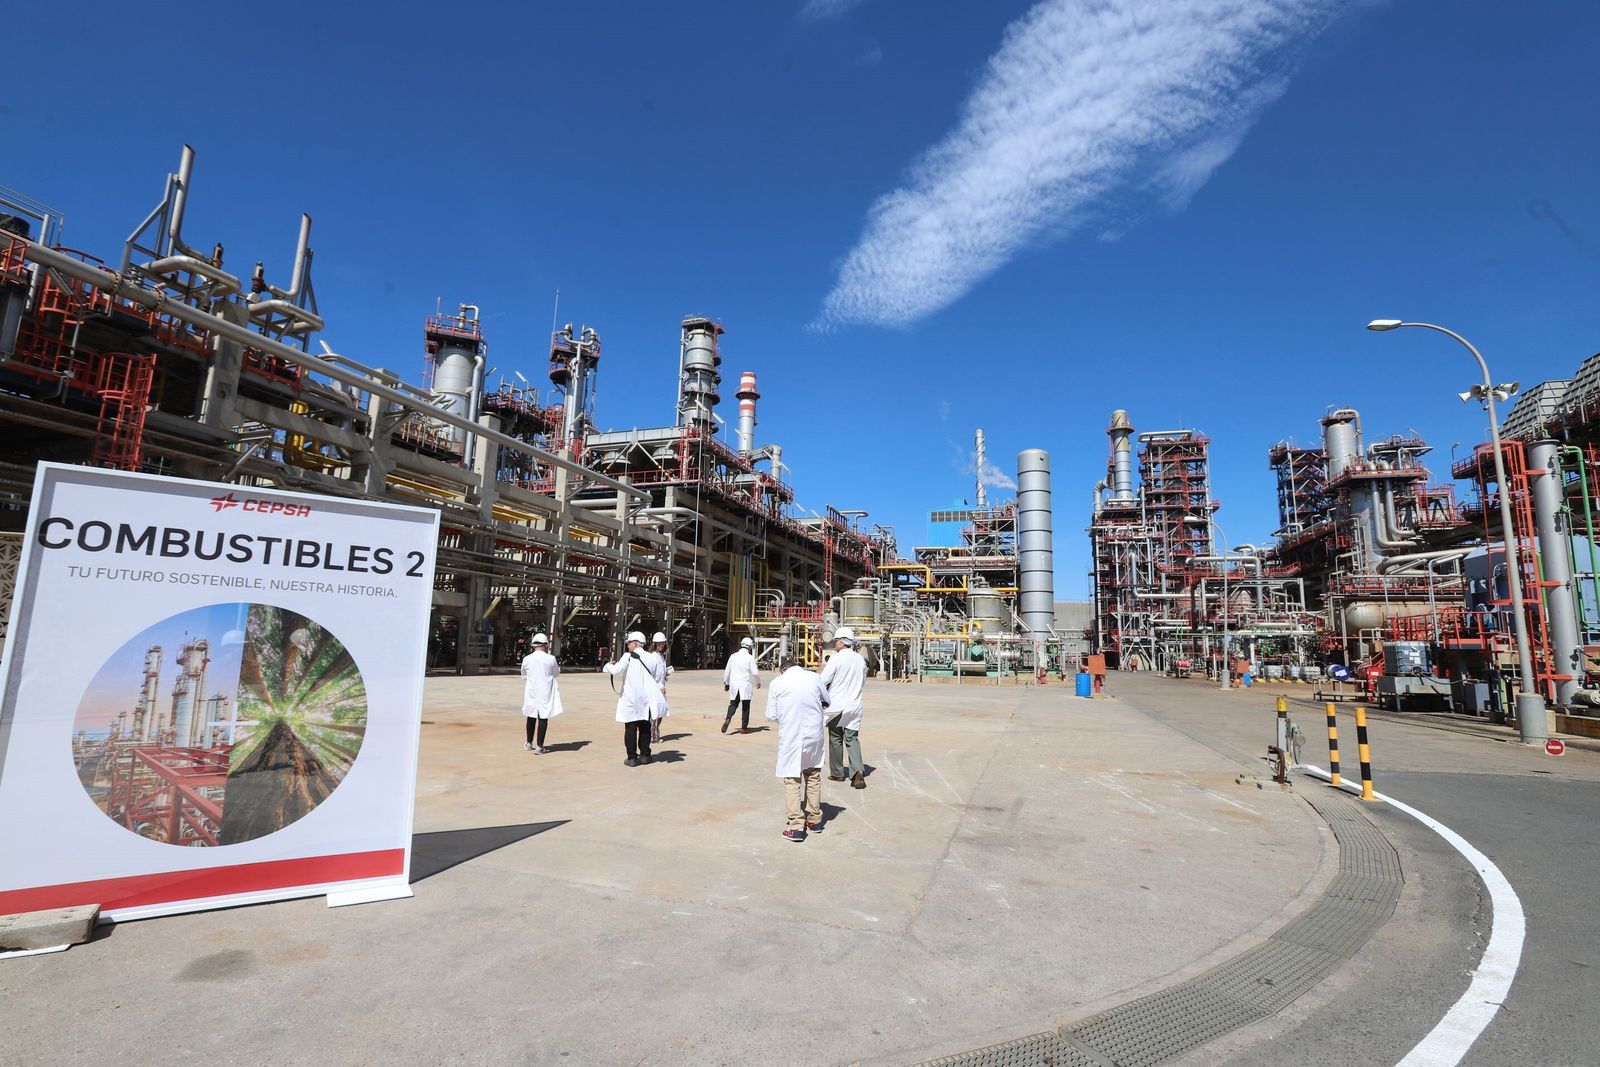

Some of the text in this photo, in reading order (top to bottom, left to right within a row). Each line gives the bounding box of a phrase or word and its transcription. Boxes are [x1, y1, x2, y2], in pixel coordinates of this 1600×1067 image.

[243, 498, 312, 518] CEPSA
[37, 516, 426, 578] COMBUSTIBLES 2
[67, 565, 398, 599] TU FUTURO SOSTENIBLE, NUESTRA HISTORIA.
